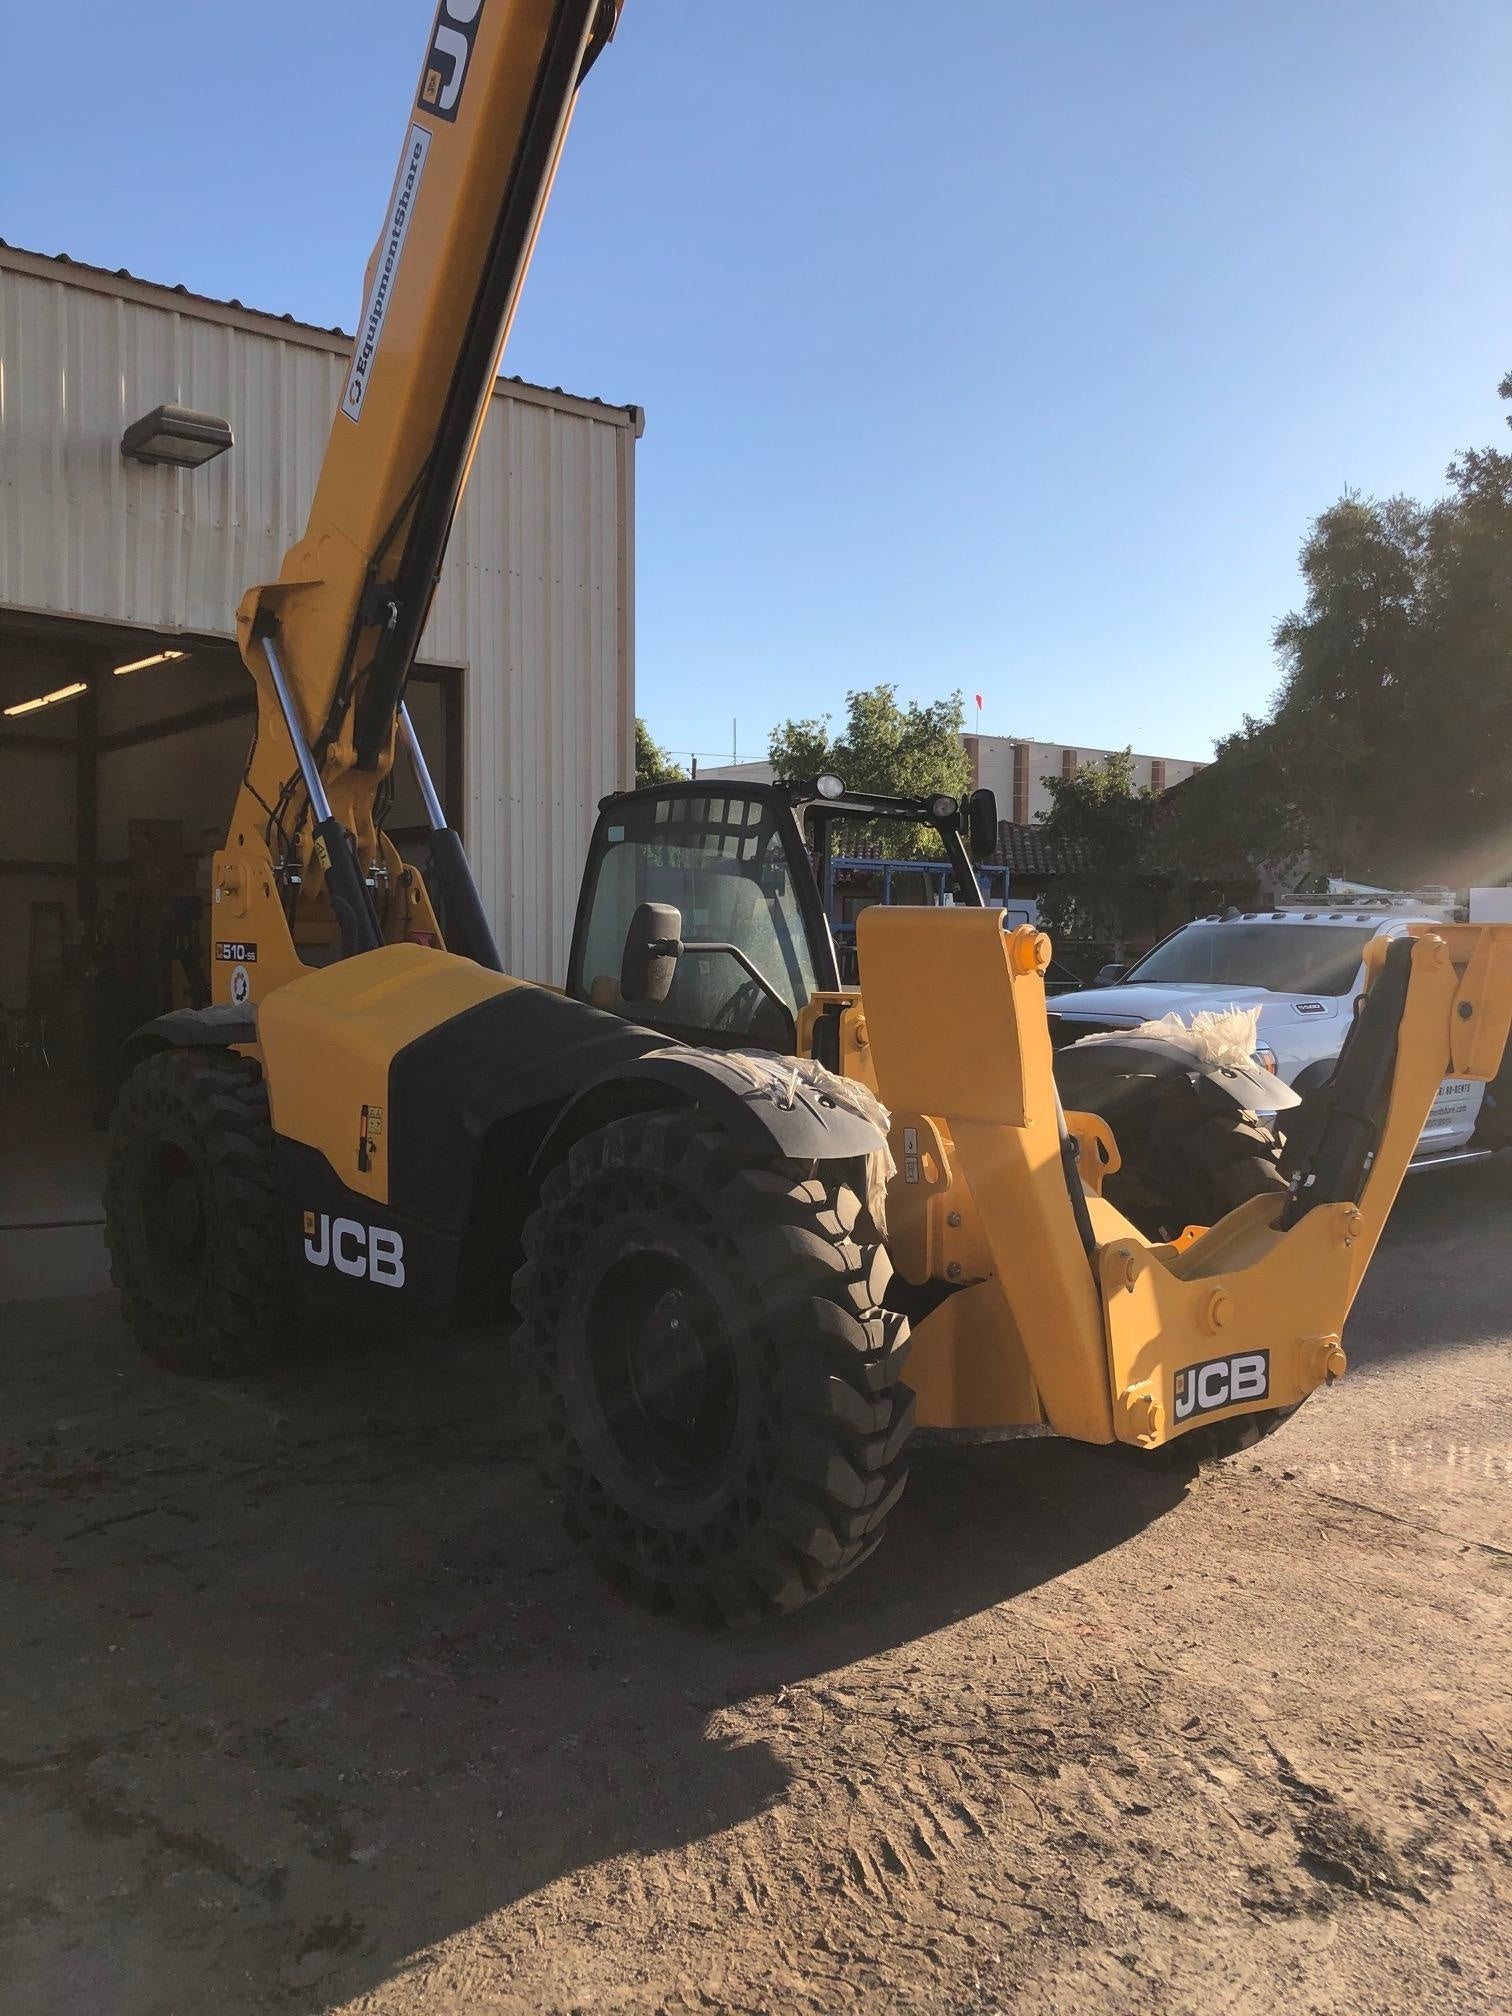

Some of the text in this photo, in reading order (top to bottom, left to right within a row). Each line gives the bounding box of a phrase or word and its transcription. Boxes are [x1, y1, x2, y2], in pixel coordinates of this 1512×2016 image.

[356, 142, 423, 378] EquipmentShare
[304, 1213, 405, 1288] JCB
[1175, 1355, 1267, 1418] JCB
